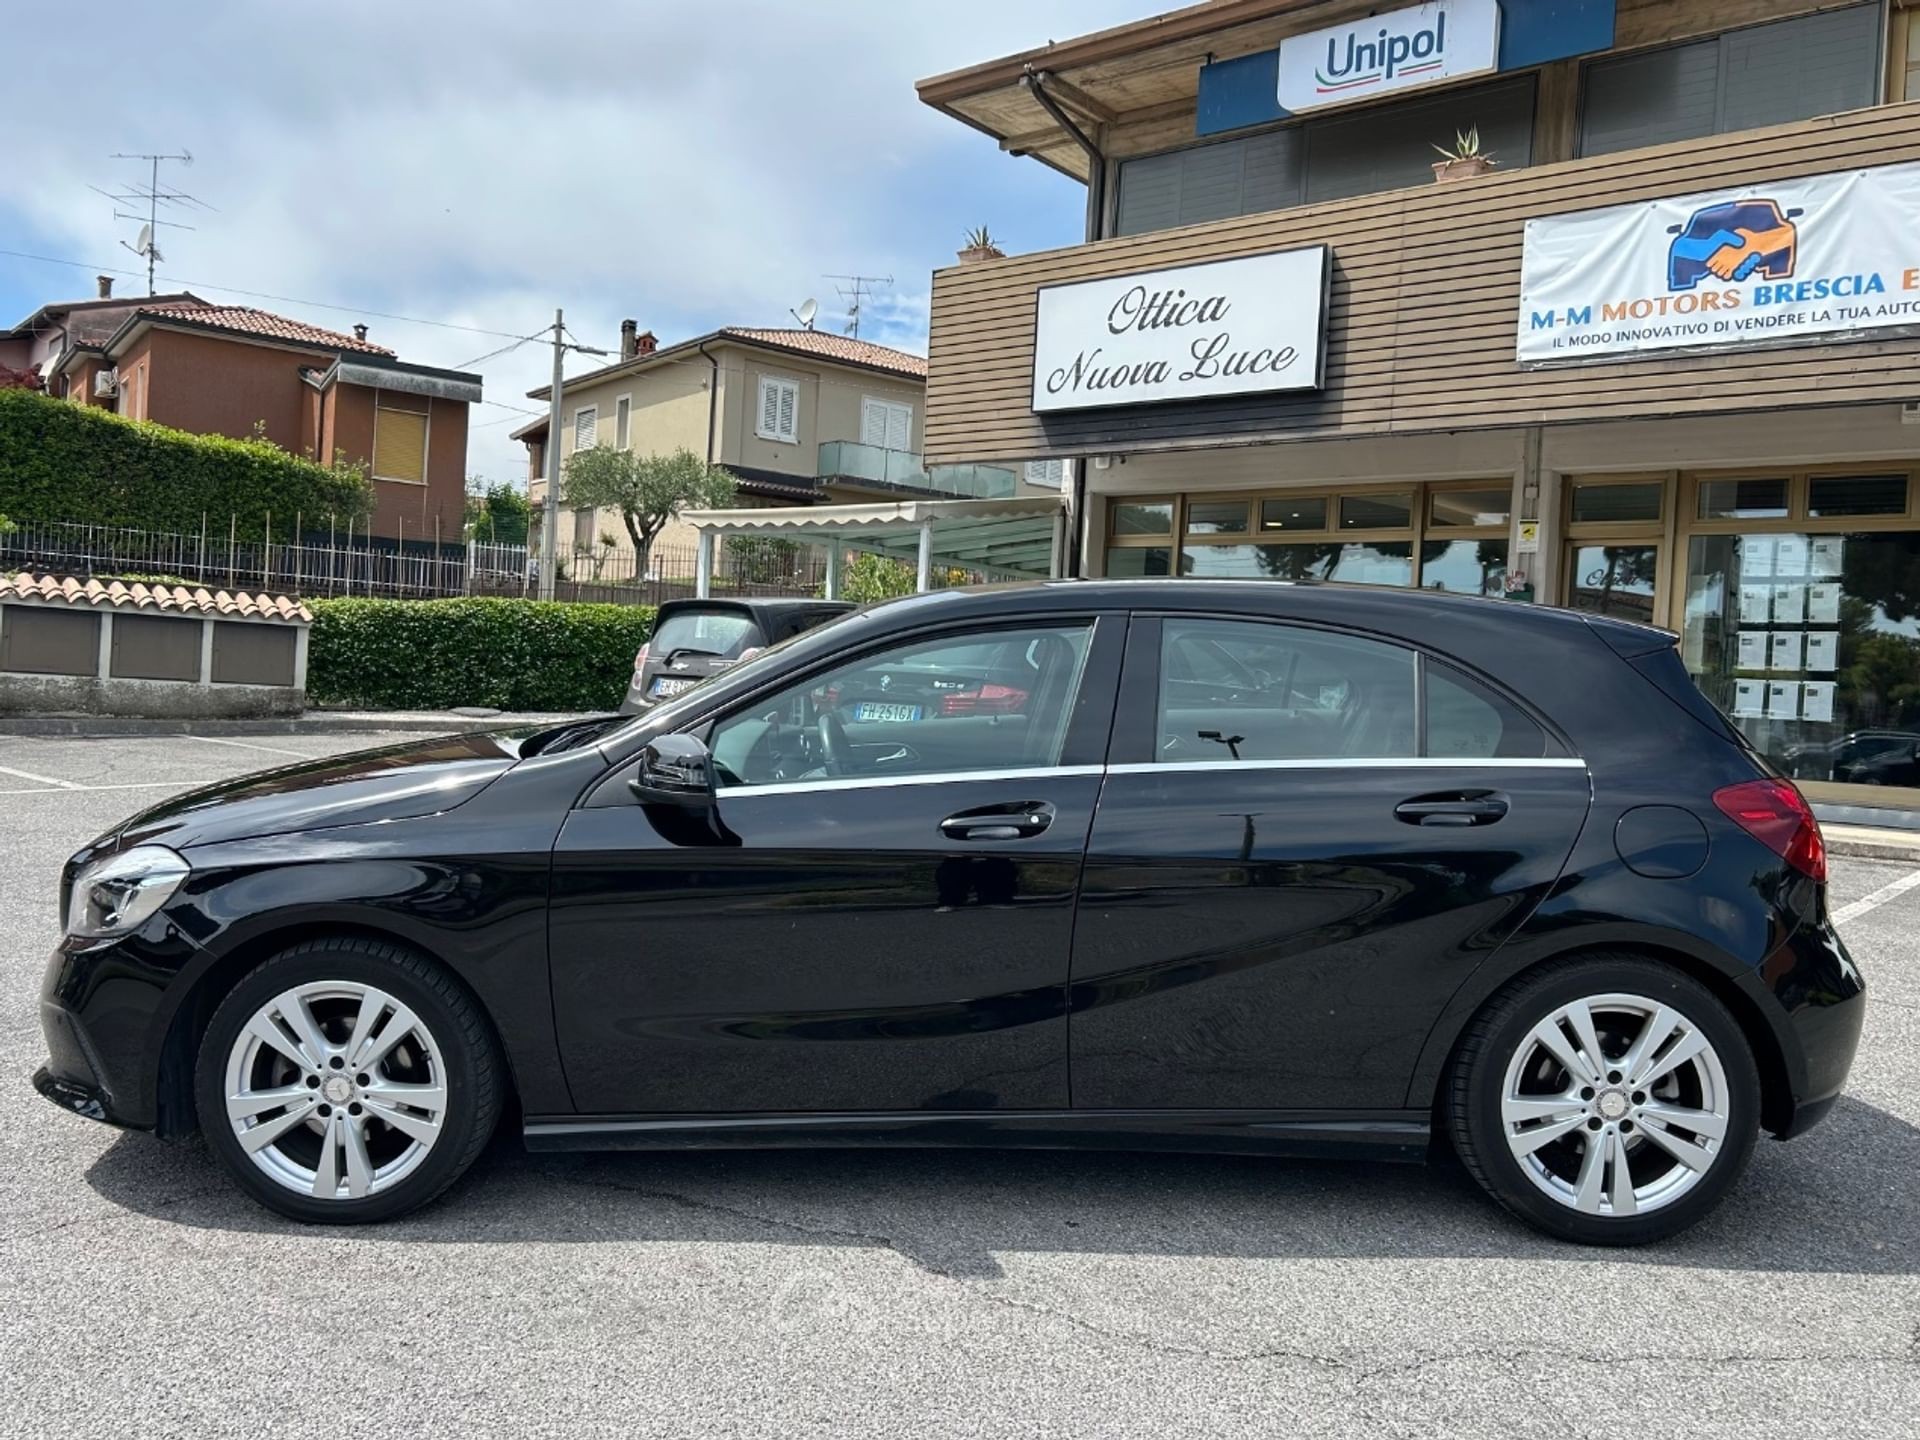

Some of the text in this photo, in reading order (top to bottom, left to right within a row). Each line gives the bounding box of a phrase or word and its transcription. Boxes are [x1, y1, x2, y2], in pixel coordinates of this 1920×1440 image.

[1327, 11, 1446, 79] Unipol
[1107, 285, 1232, 335] Ottica
[1531, 305, 1591, 330] M-M
[1602, 289, 1742, 322] MOTORS
[1753, 272, 1886, 306] BRESCIA
[1553, 338, 1565, 348] IL
[1568, 332, 1612, 347] MODO
[1616, 322, 1709, 342] INNOVATIVO
[1713, 320, 1729, 333] DI
[1735, 312, 1806, 330] VENDERE
[1811, 310, 1831, 323] LA
[1837, 305, 1871, 320] TUA
[1046, 332, 1299, 394] Nuova Luce
[862, 703, 876, 718] FH
